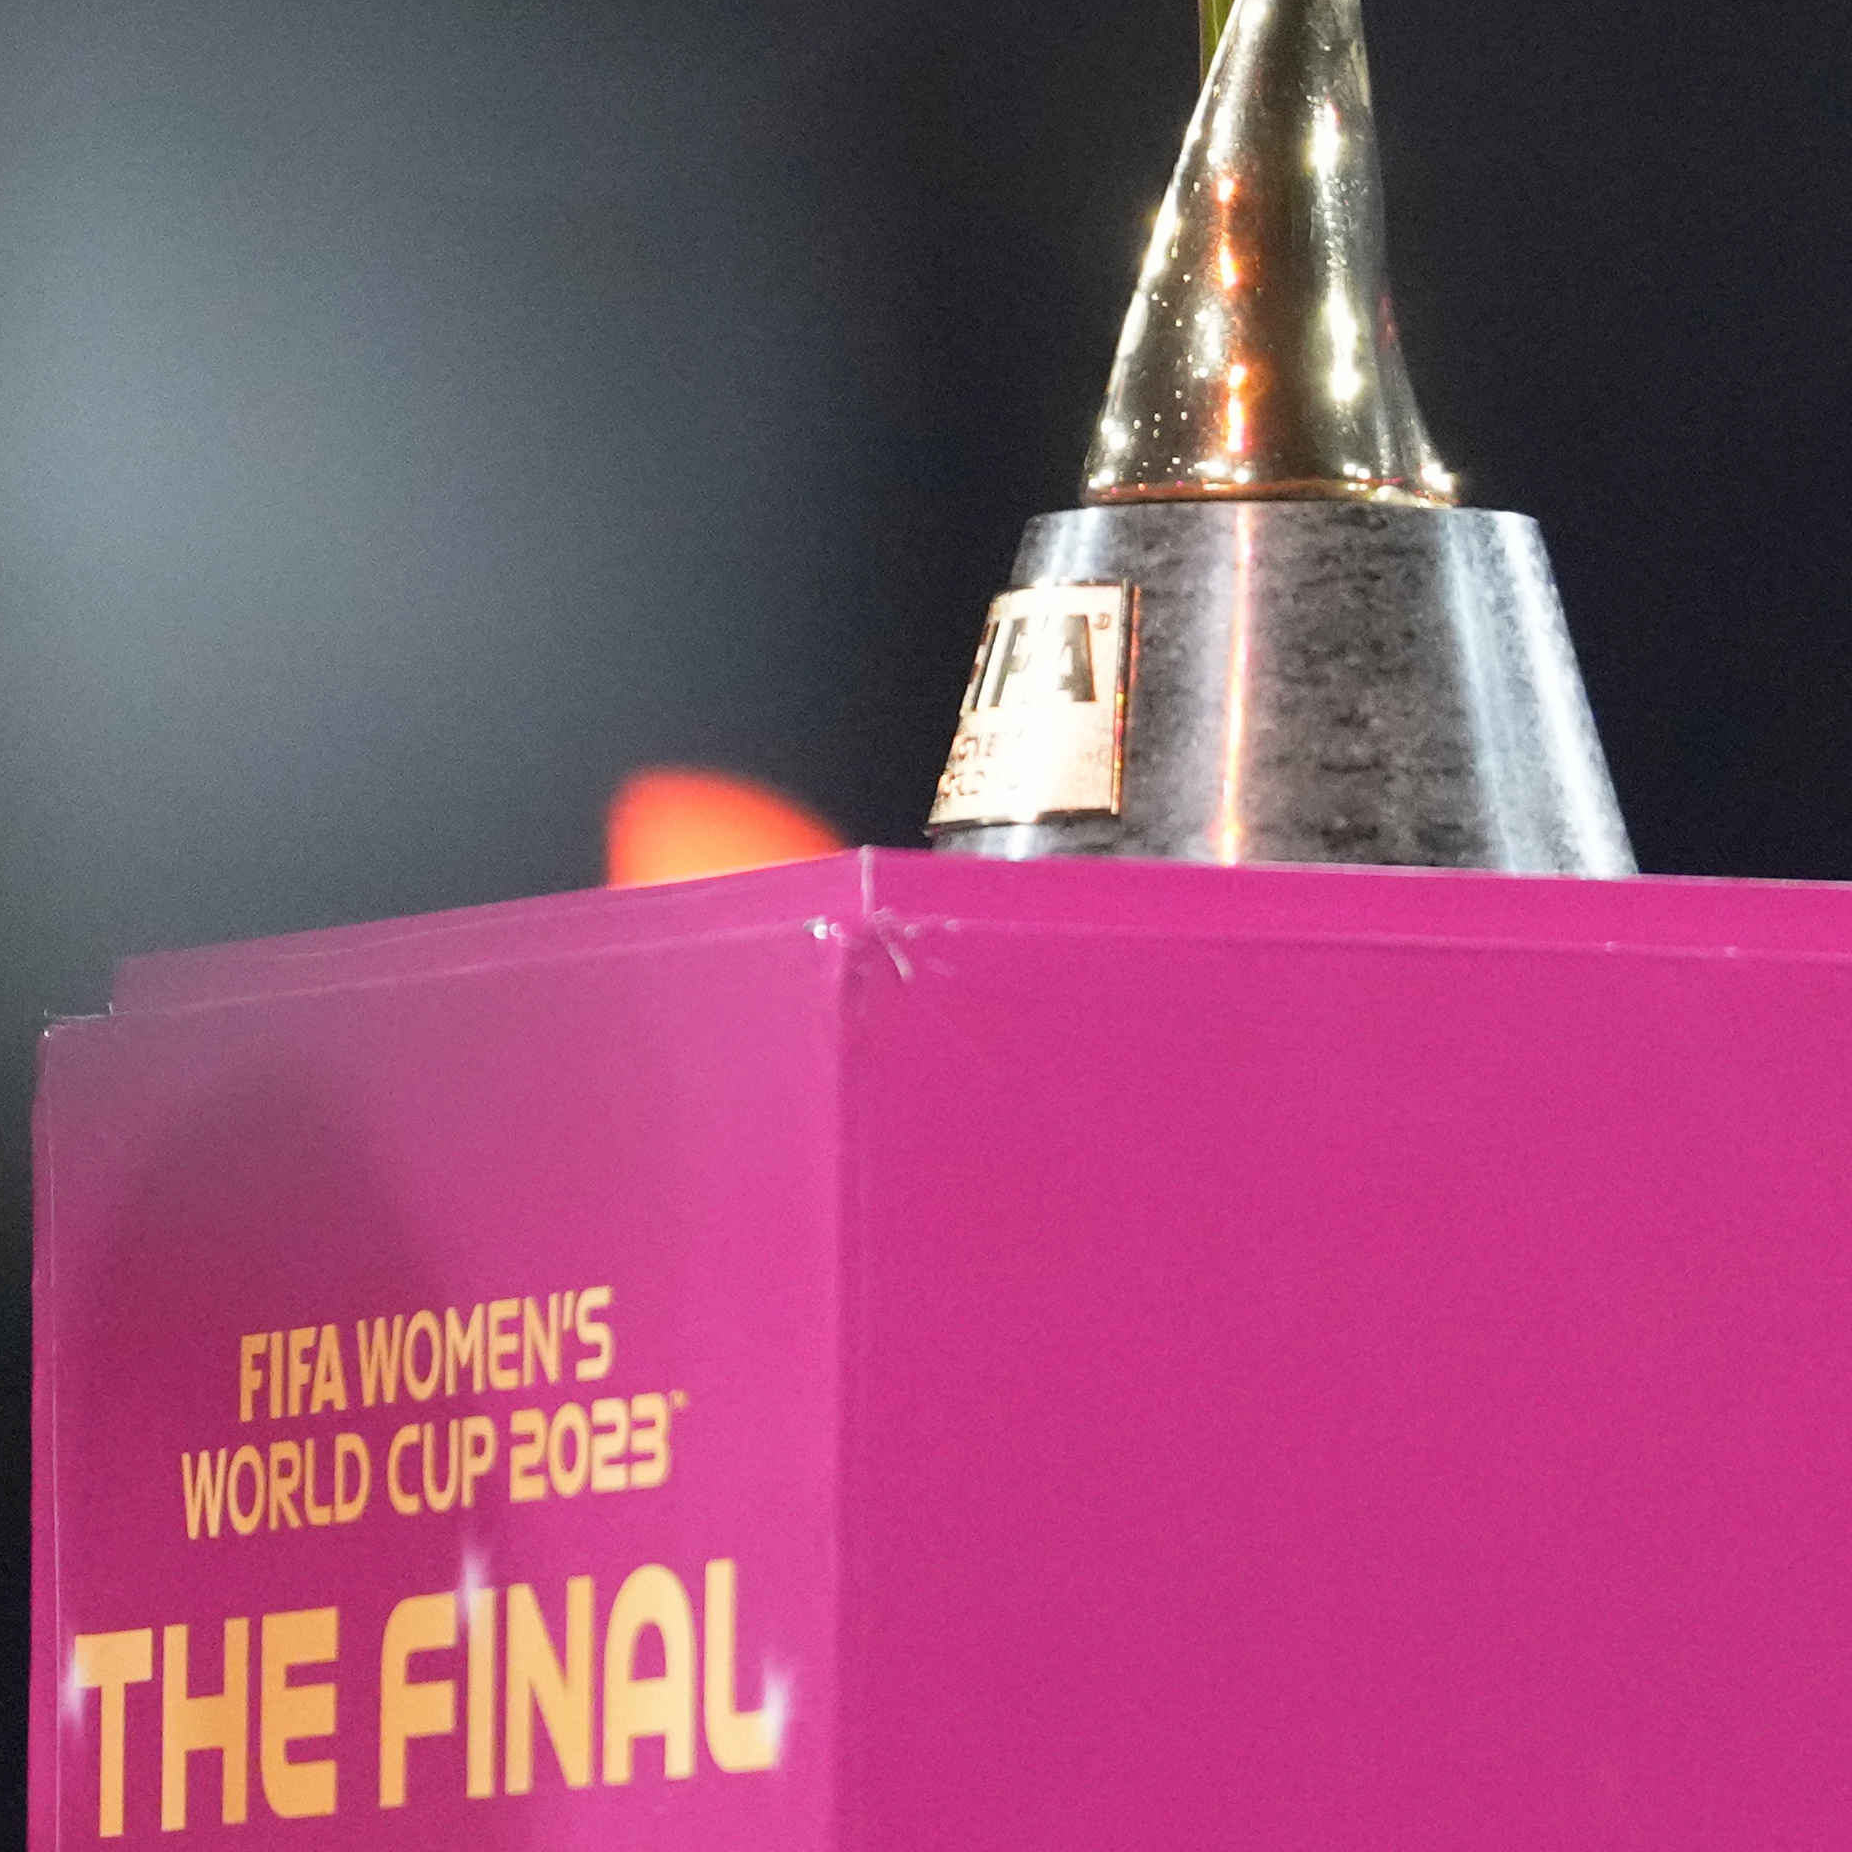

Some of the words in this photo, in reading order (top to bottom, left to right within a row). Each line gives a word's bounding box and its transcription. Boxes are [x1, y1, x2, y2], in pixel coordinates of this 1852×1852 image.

[238, 1322, 348, 1423] FIFA
[356, 1284, 615, 1408] WOMEN'S
[181, 1430, 372, 1540] WORLD
[387, 1414, 498, 1516] CUP
[72, 1606, 341, 1838] THE
[379, 1558, 782, 1809] FINAL
